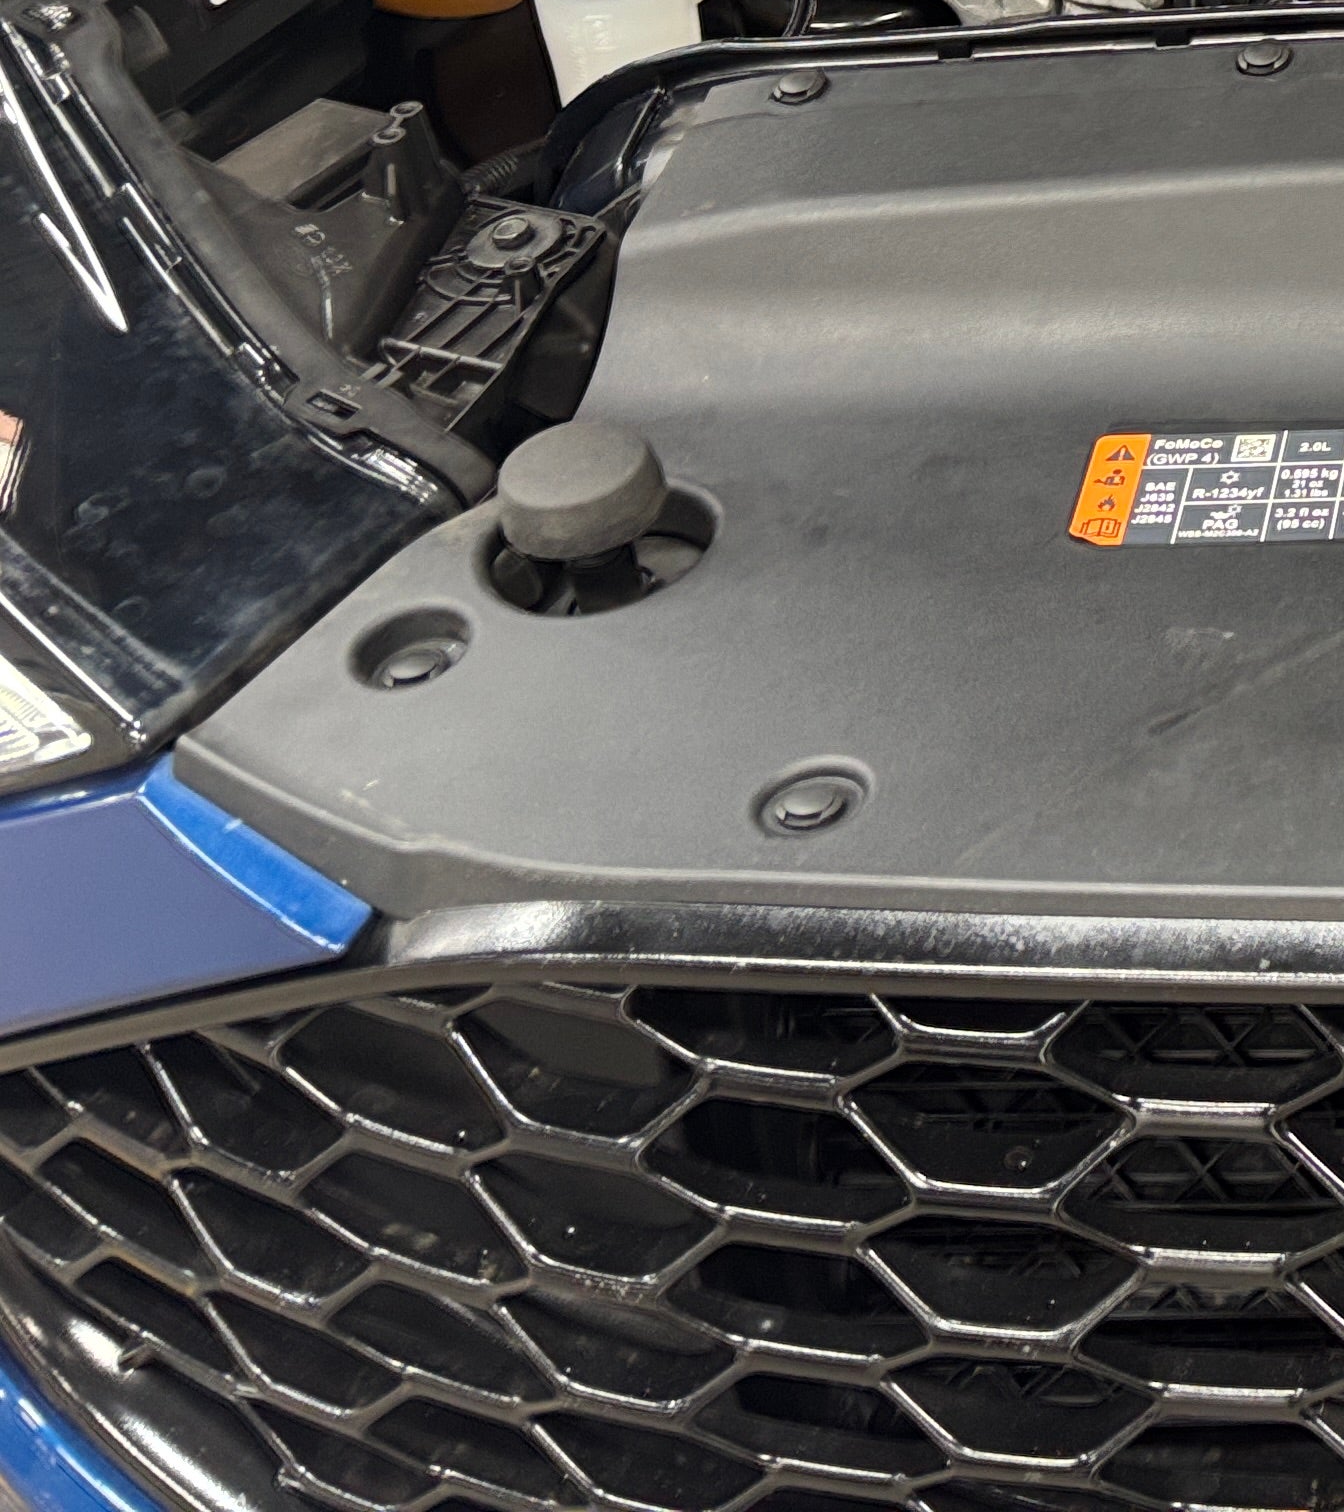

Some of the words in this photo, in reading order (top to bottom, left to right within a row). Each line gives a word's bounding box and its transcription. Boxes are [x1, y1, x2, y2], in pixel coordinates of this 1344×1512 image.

[1154, 438, 1223, 450] FoMoCo
[1299, 441, 1331, 453] 2.0L
[1146, 453, 1198, 466] (GWP
[1200, 452, 1220, 465] 4)
[1320, 467, 1339, 480] kg
[1145, 481, 1176, 492] SAE
[1292, 480, 1307, 489] 21
[1308, 480, 1324, 488] oz
[1139, 492, 1174, 502] J639
[1192, 486, 1265, 500] R-1234yf
[1274, 507, 1297, 518] 3.2
[1311, 507, 1330, 517] oz
[1202, 518, 1239, 530] PAG
[1276, 519, 1300, 531] (95
[1301, 518, 1325, 530] cc)
